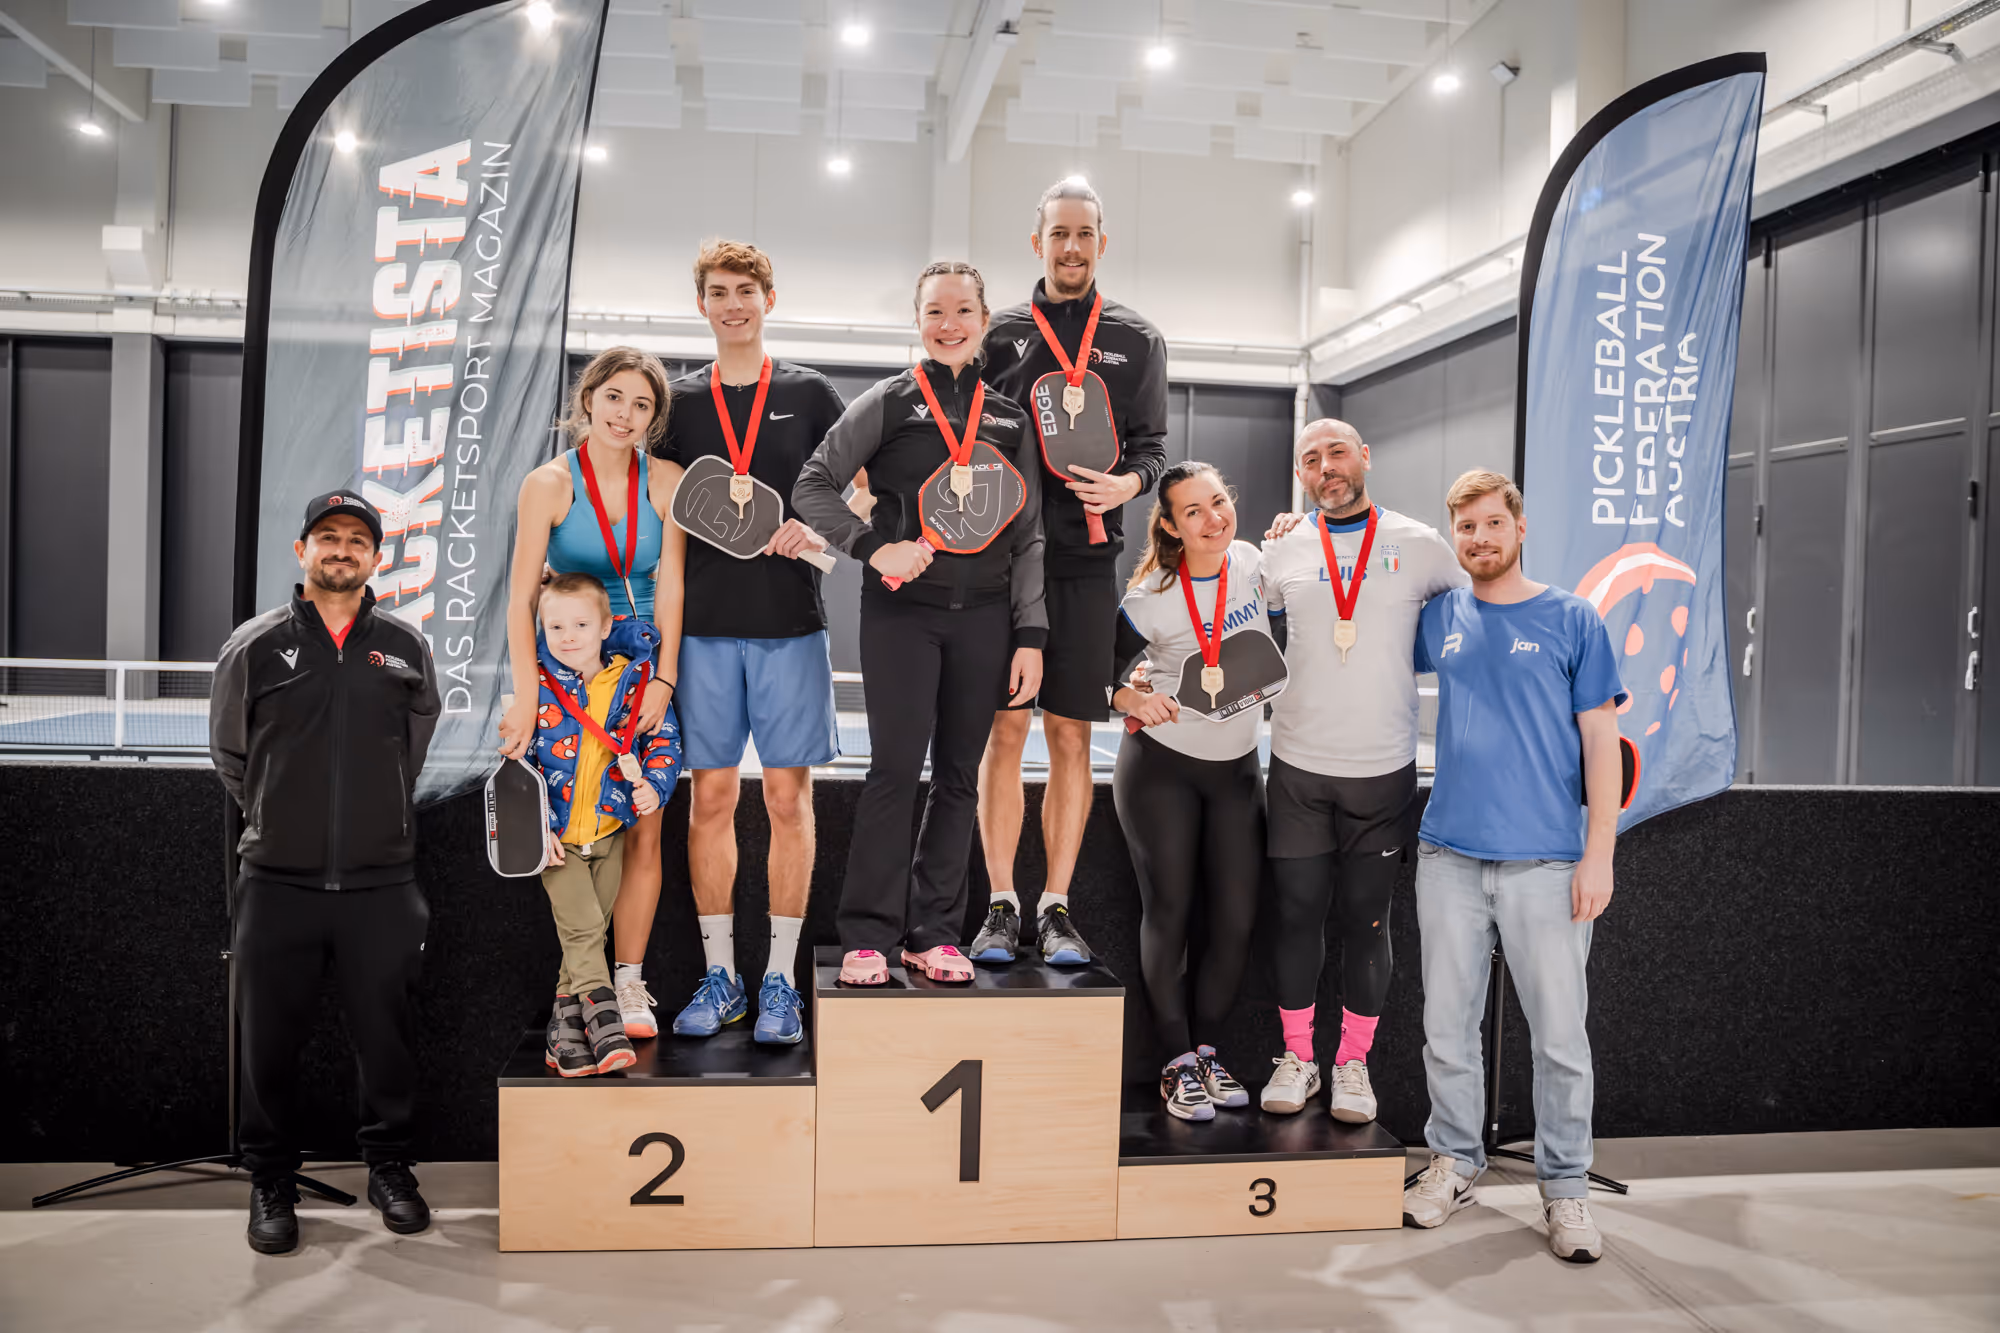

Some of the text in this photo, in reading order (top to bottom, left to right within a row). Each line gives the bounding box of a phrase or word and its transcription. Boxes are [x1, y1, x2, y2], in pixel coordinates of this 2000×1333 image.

[1036, 384, 1058, 437] EDGE
[1592, 250, 1627, 525] PICKLEBALL
[1629, 232, 1667, 526] FEDERATION
[445, 141, 512, 714] DAS RACKETSPORT MAGAZIN
[1202, 599, 1260, 638] SMMY
[1510, 637, 1540, 654] jan
[921, 1059, 983, 1183] 1
[628, 1132, 686, 1206] 2
[1248, 1177, 1277, 1217] 3
